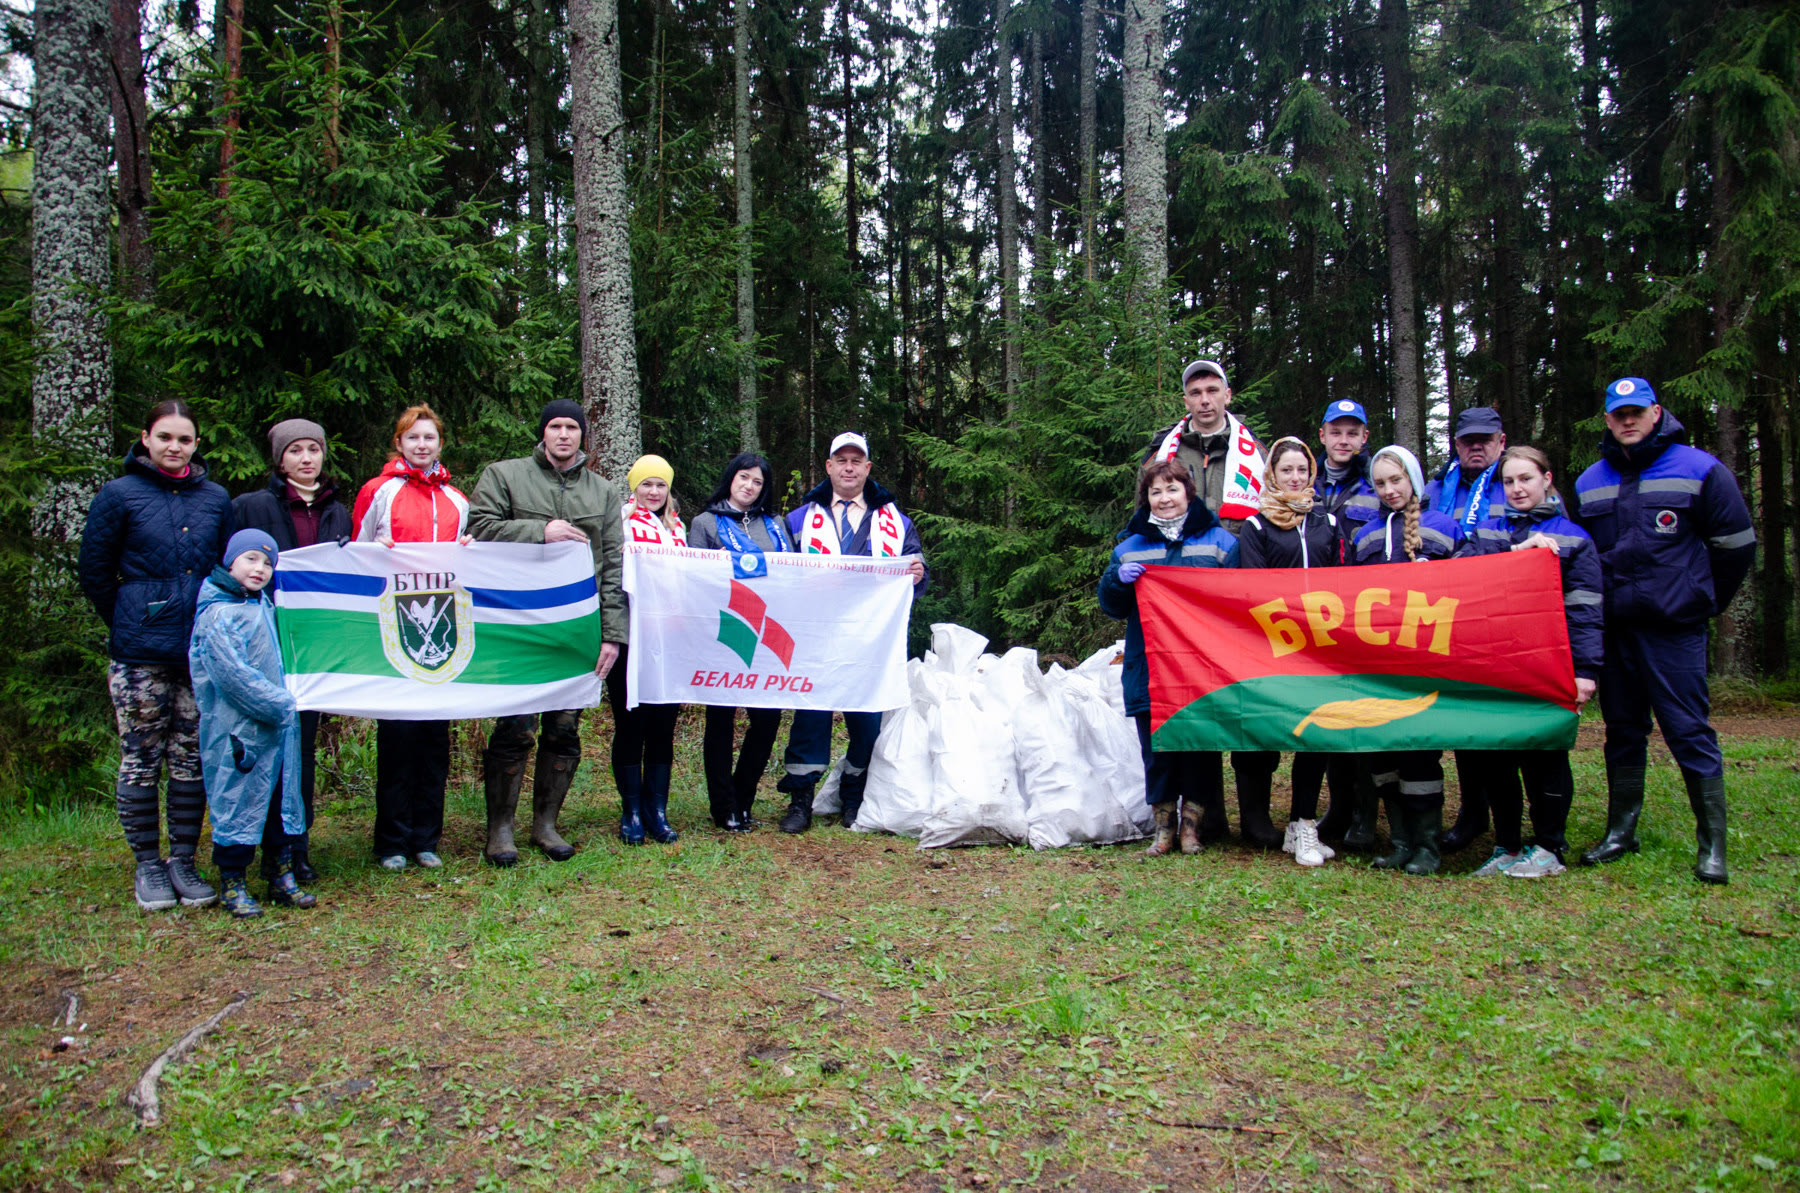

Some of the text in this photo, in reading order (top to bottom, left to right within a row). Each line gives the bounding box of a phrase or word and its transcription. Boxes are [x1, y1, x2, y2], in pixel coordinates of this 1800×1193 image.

[393, 571, 456, 592] БТПР
[1248, 587, 1460, 658] БРСМ
[690, 670, 814, 693] БЕЛАЯ РУСЬ
